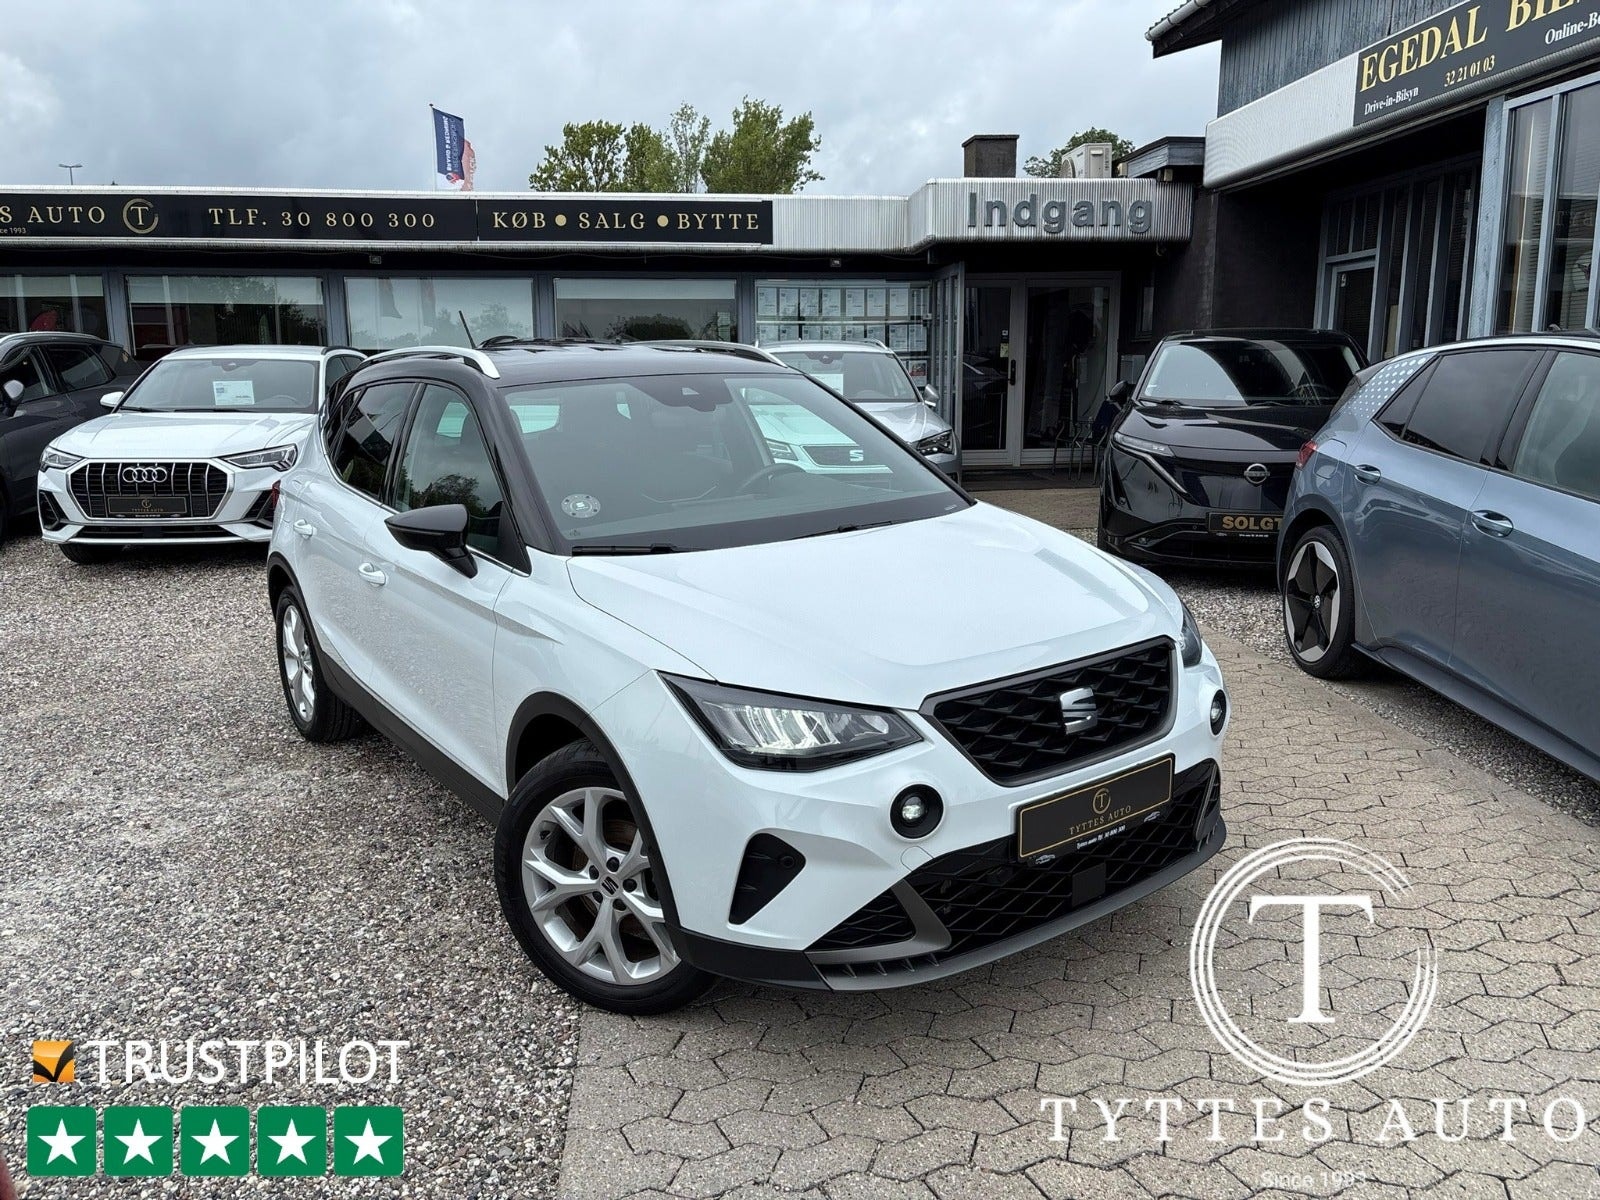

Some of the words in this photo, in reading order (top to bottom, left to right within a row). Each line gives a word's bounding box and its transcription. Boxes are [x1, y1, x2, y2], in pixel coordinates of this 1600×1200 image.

[1359, 5, 1489, 92] EGEDAL
[1444, 70, 1456, 87] 32
[1456, 65, 1468, 83] 21
[1469, 60, 1481, 78] 01
[1483, 54, 1496, 73] 03
[1364, 86, 1419, 116] Drive-in-Bilsyn
[27, 206, 105, 224] AUTO
[208, 208, 268, 226] TLF.
[281, 211, 311, 227] 30
[326, 212, 374, 228] 800
[388, 212, 436, 229] 300
[493, 211, 546, 229] KØB
[578, 212, 646, 230] SALG
[677, 212, 760, 230] BYTTE
[966, 191, 1153, 234] Indgang
[1222, 515, 1284, 530] SOLGT
[1069, 815, 1105, 835] TYTTES
[1108, 805, 1131, 821] AUTO
